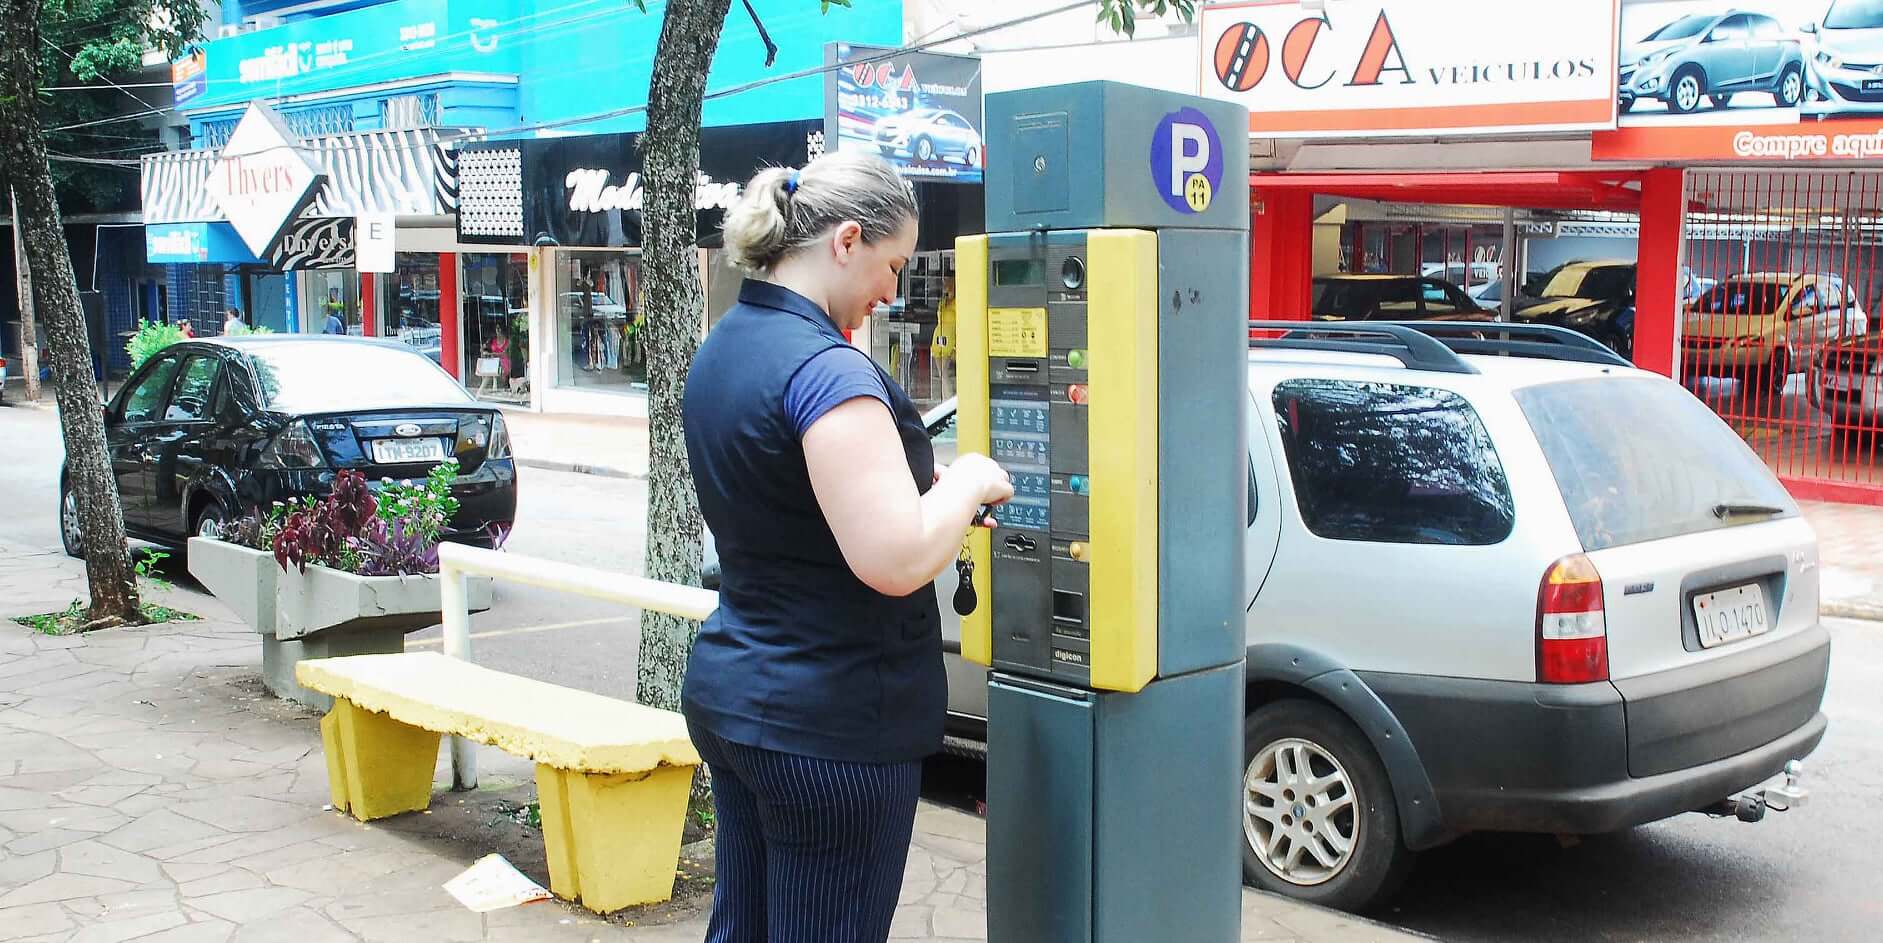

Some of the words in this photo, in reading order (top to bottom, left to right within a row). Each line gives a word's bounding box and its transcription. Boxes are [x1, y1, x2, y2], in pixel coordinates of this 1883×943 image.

[1214, 8, 1416, 92] OCA
[853, 62, 920, 91] OCA
[1733, 131, 1827, 159] Compre
[1171, 122, 1210, 197] P
[1192, 179, 1205, 189] PA
[1191, 192, 1205, 205] 11
[370, 222, 381, 240] E
